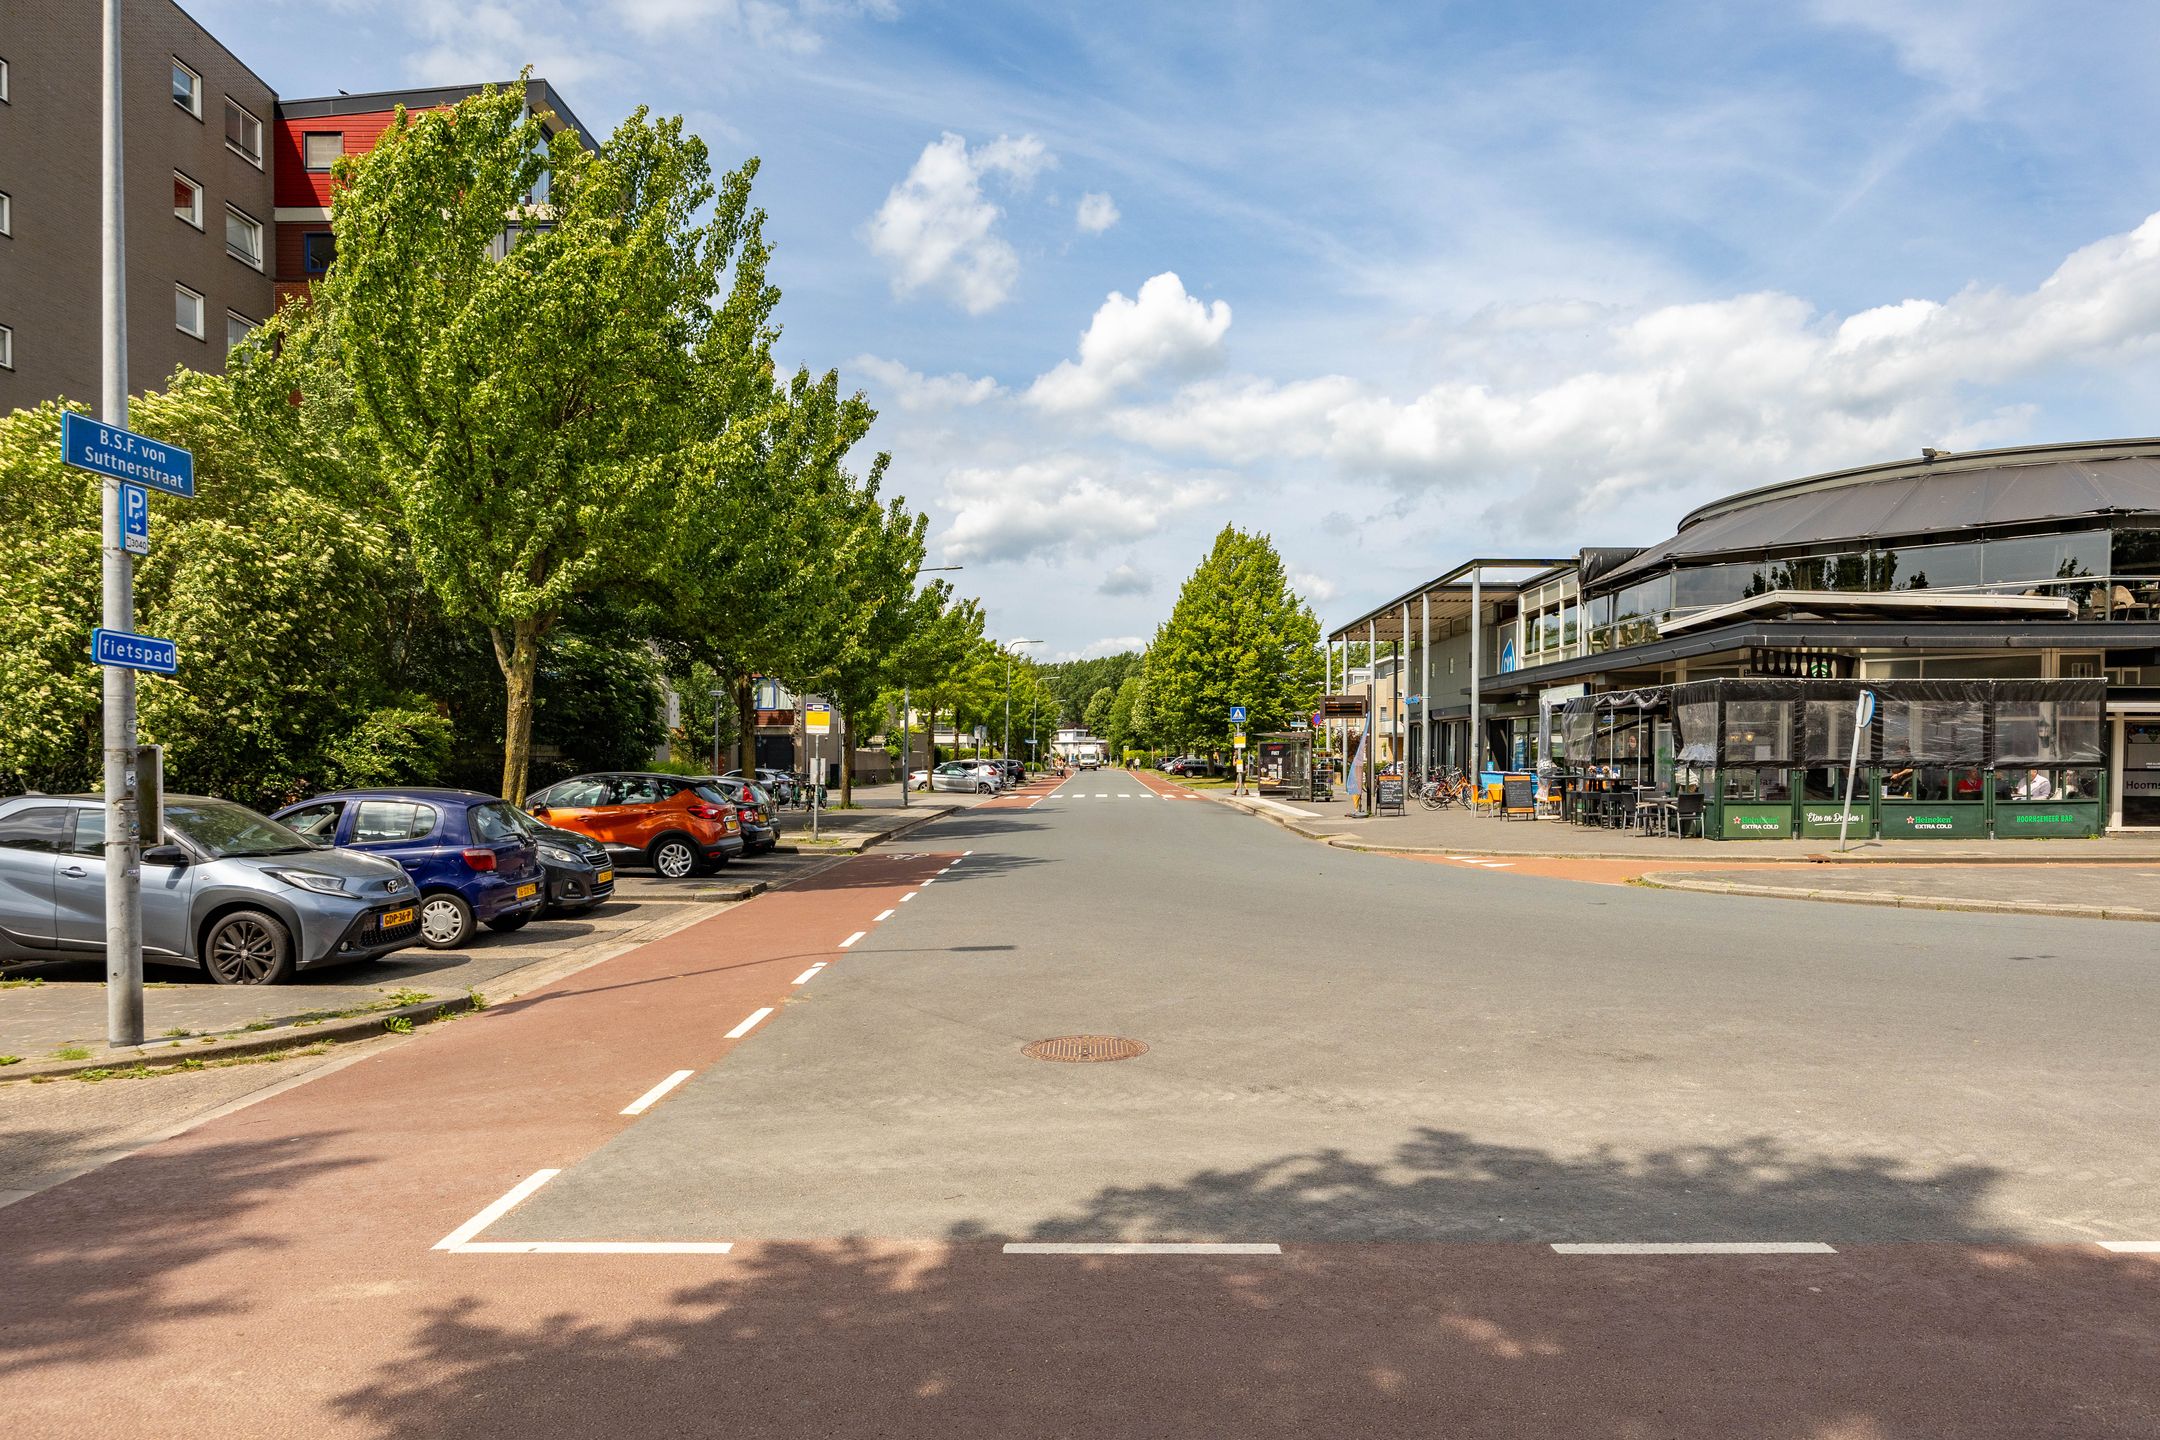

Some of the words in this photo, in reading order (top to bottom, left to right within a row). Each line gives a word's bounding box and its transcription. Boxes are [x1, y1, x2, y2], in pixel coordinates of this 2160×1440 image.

[100, 429, 137, 455] B.S.F.
[141, 446, 166, 464] von
[85, 446, 183, 489] Suttnerstraat
[128, 489, 144, 518] P
[103, 639, 172, 663] fietspad
[1915, 816, 1952, 824] Heineken
